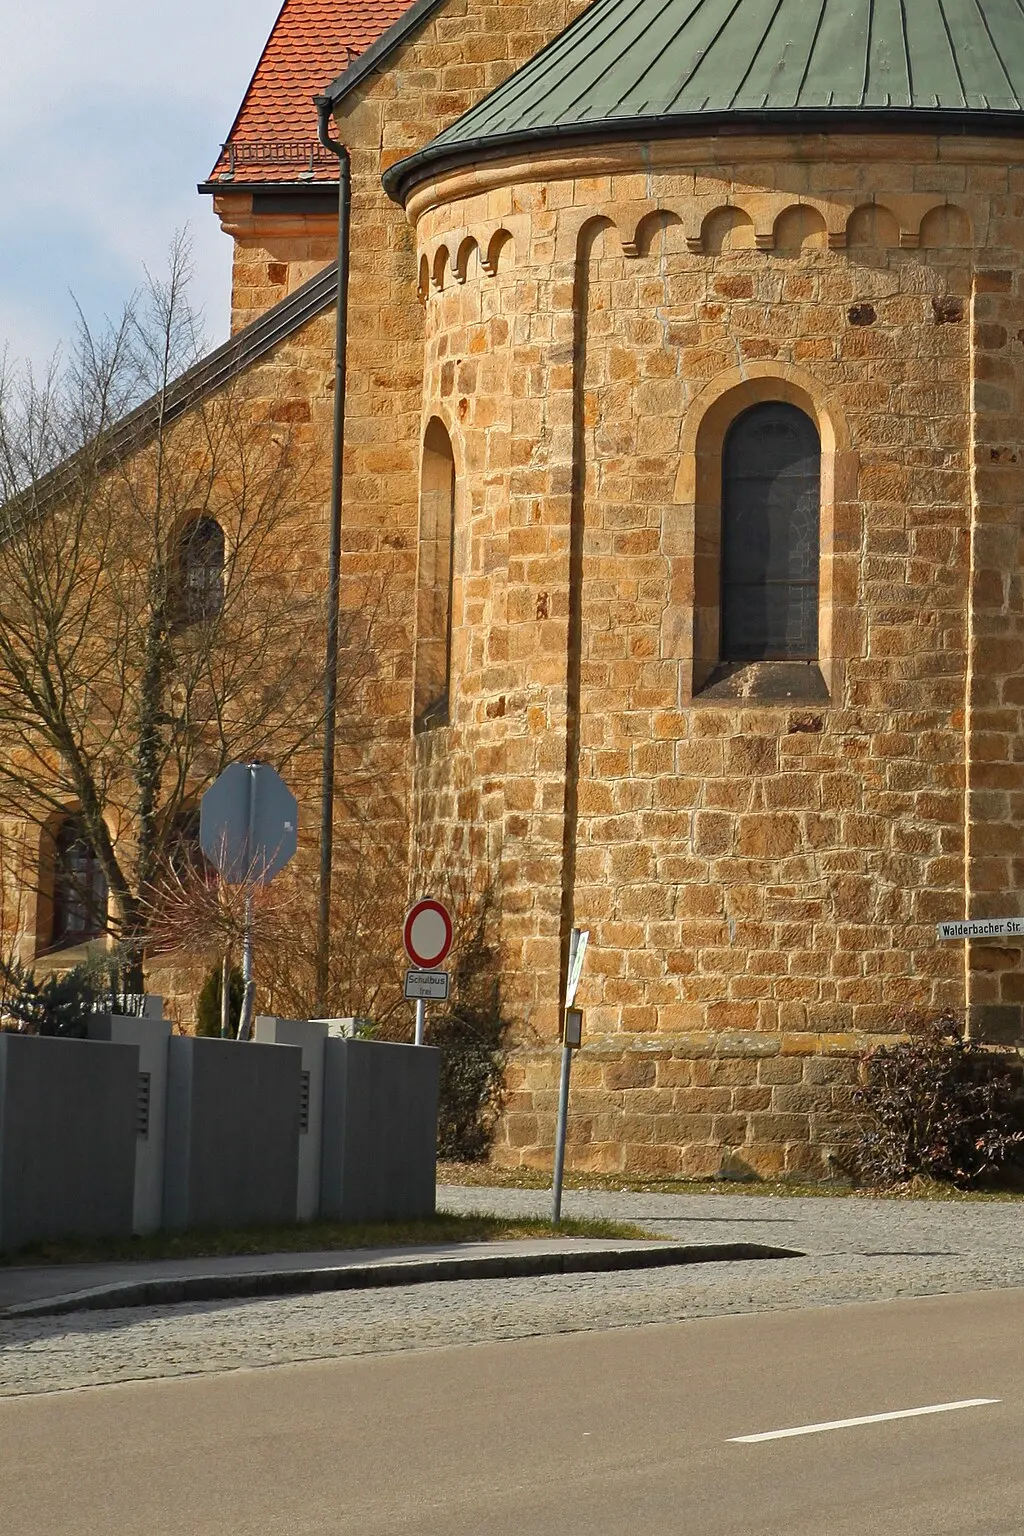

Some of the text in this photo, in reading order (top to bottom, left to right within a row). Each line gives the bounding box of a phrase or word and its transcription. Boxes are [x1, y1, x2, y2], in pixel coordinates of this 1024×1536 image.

[942, 920, 1021, 936] Walderbacher Str.
[408, 975, 445, 984] Schulbus
[420, 987, 431, 995] frei
